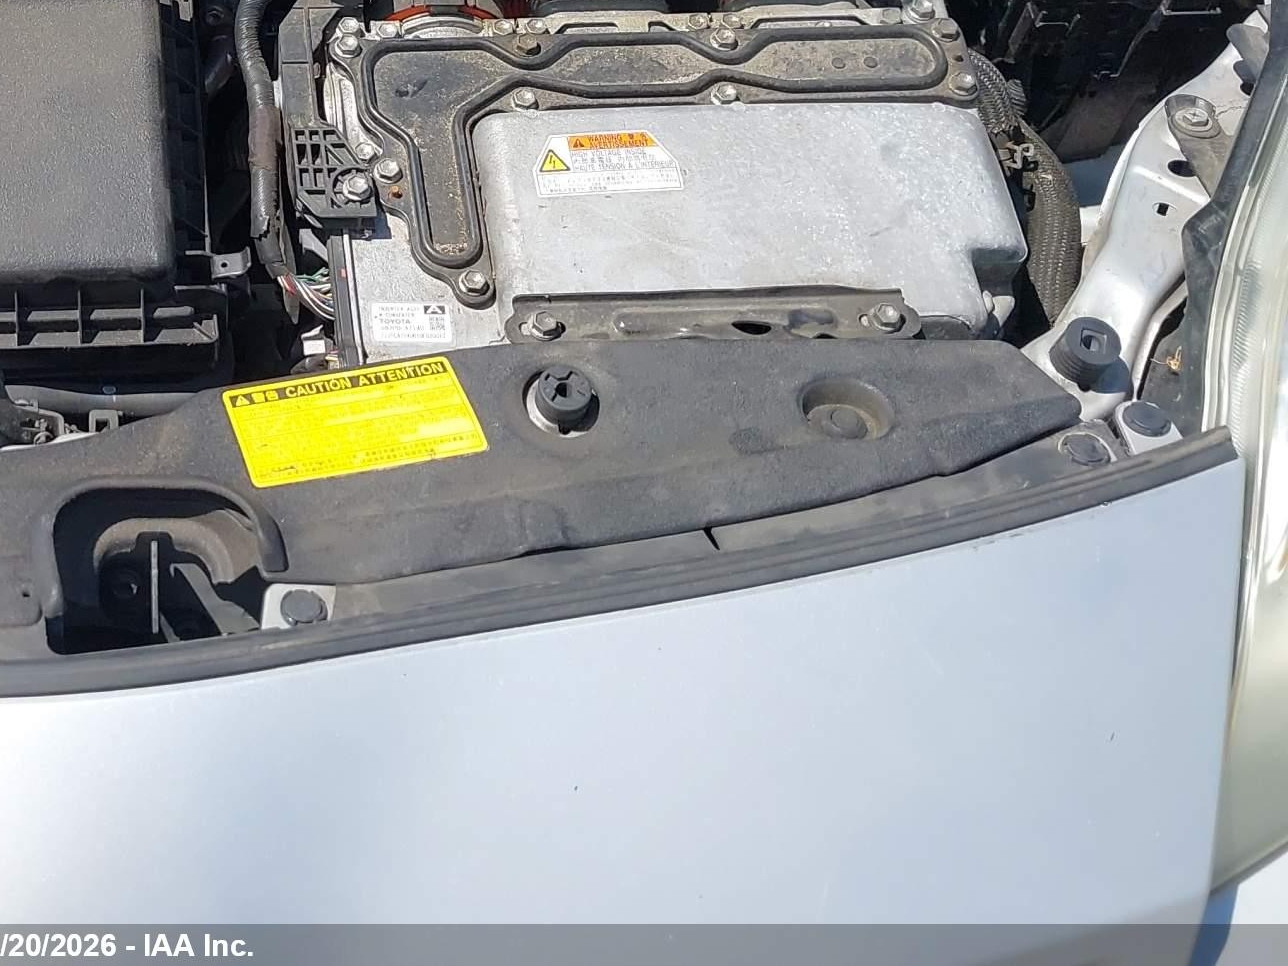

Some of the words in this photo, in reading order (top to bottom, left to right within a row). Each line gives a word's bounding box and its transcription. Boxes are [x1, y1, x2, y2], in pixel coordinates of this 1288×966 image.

[588, 134, 622, 143] WARNING
[590, 139, 648, 149] AVERTISSEMENT
[286, 377, 352, 398] CAUTION
[358, 362, 445, 387] ATTENTION
